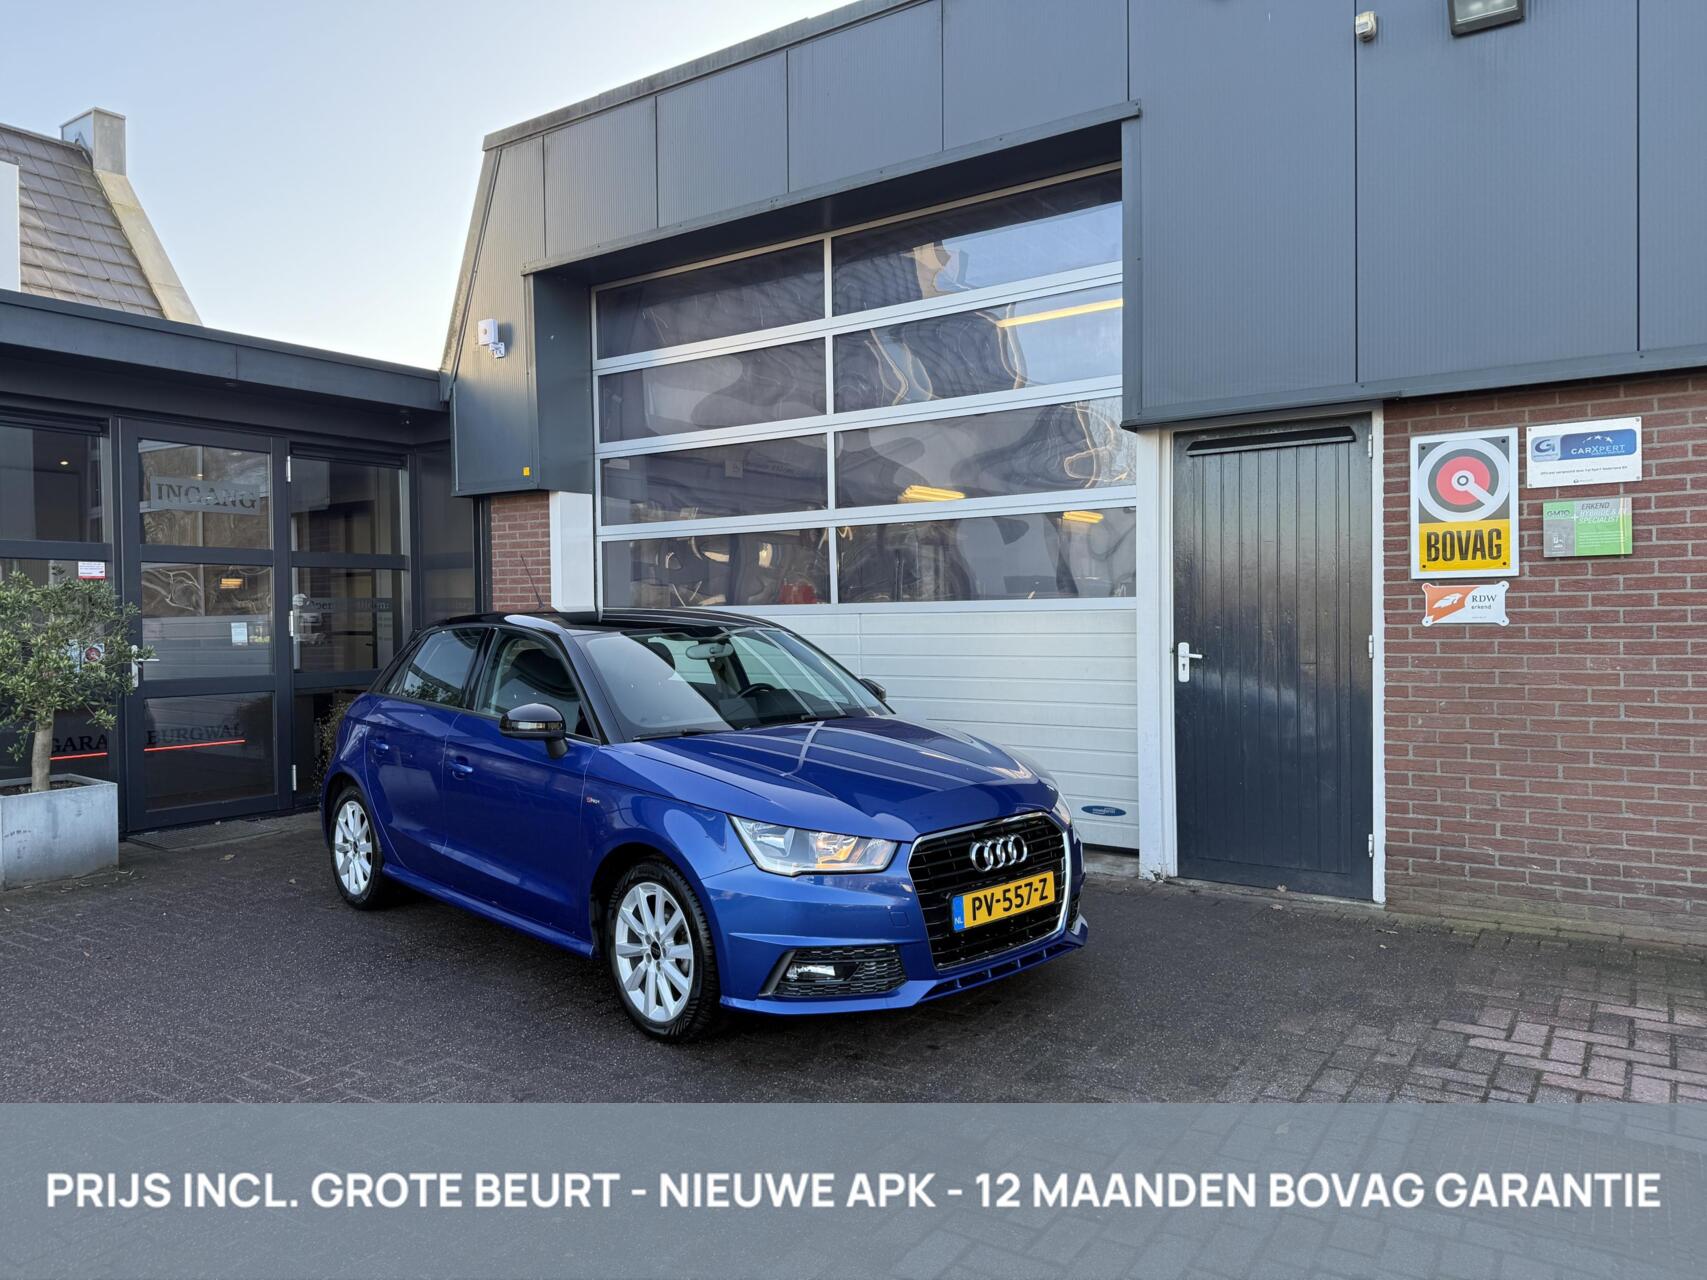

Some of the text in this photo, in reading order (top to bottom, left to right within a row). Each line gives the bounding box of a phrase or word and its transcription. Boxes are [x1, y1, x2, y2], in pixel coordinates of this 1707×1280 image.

[156, 483, 257, 509] INGANG
[1581, 502, 1610, 510] ERKEND
[1426, 528, 1502, 562] BOVAG
[1472, 594, 1497, 603] RDW
[146, 723, 245, 746] BURGWAL
[971, 877, 1048, 921] PV-557-Z
